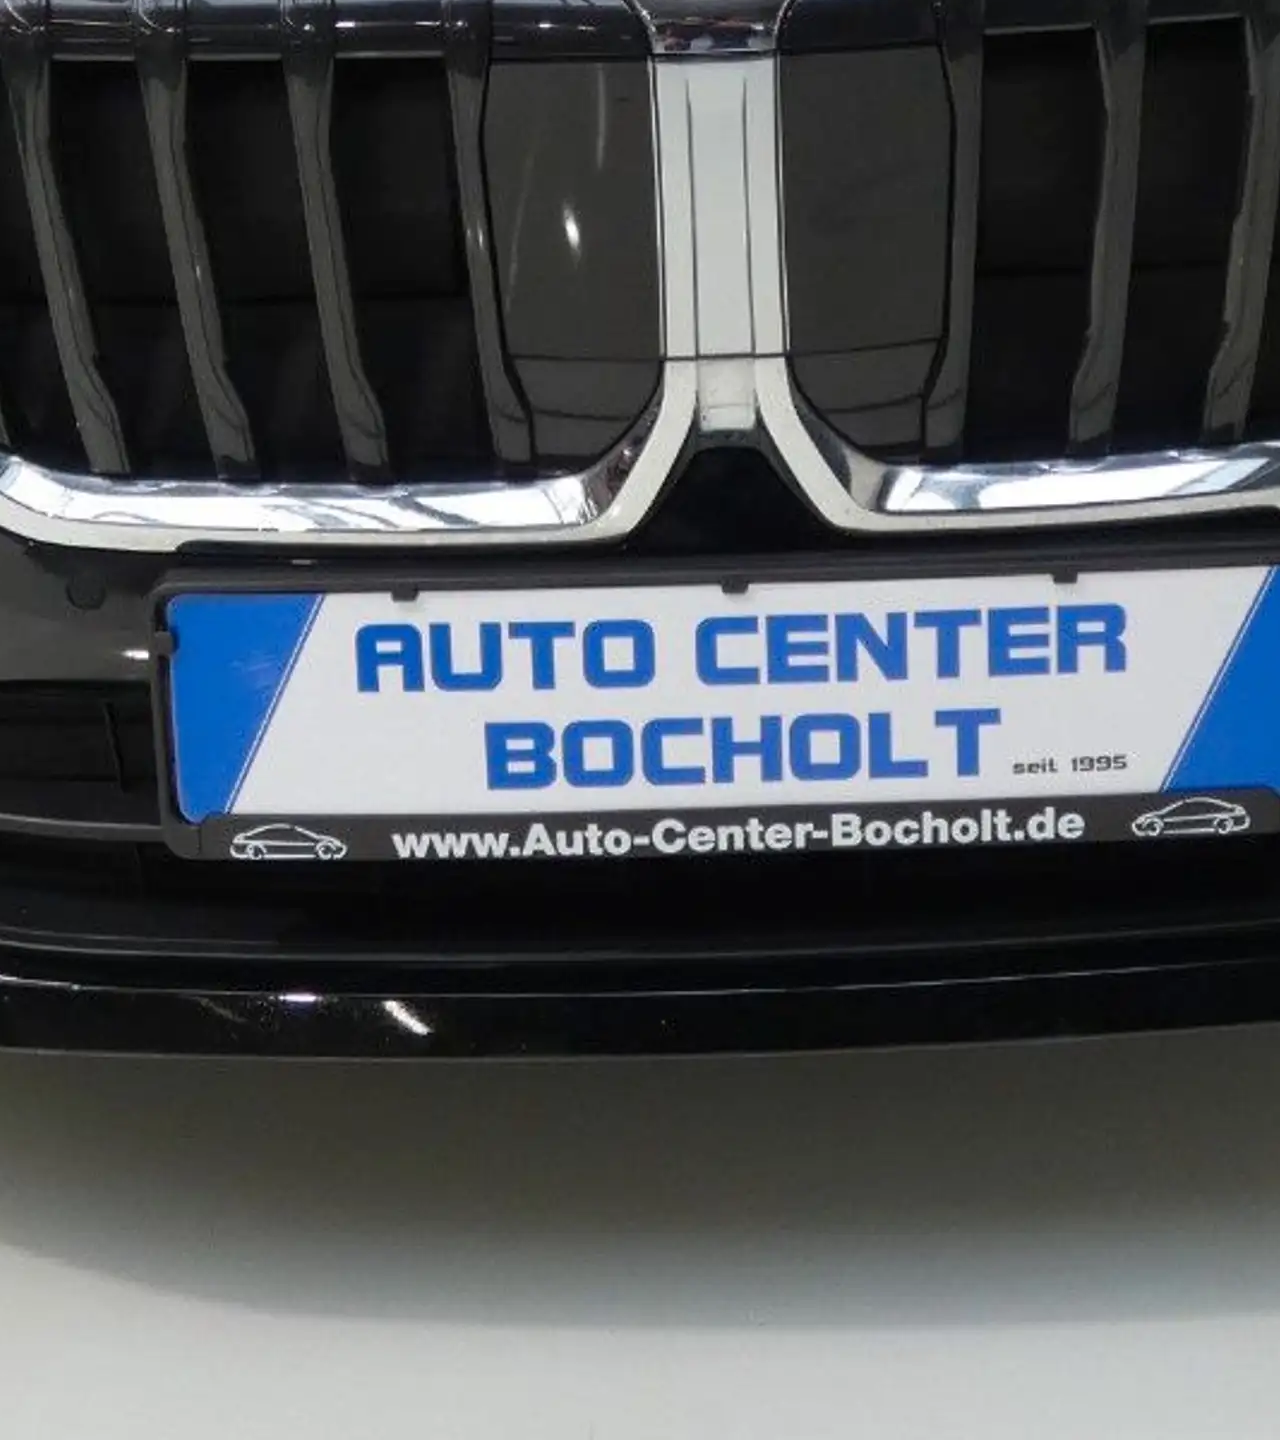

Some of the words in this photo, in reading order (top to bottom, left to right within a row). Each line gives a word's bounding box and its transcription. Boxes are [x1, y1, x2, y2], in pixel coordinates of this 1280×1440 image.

[355, 618, 655, 693] AUTO
[695, 603, 1127, 686] CENTER
[484, 708, 1000, 790] BOCHOLT
[1012, 757, 1058, 775] seit
[1071, 754, 1128, 773] 1995
[391, 806, 1086, 859] www.Auto-Center-Bocholt.de
